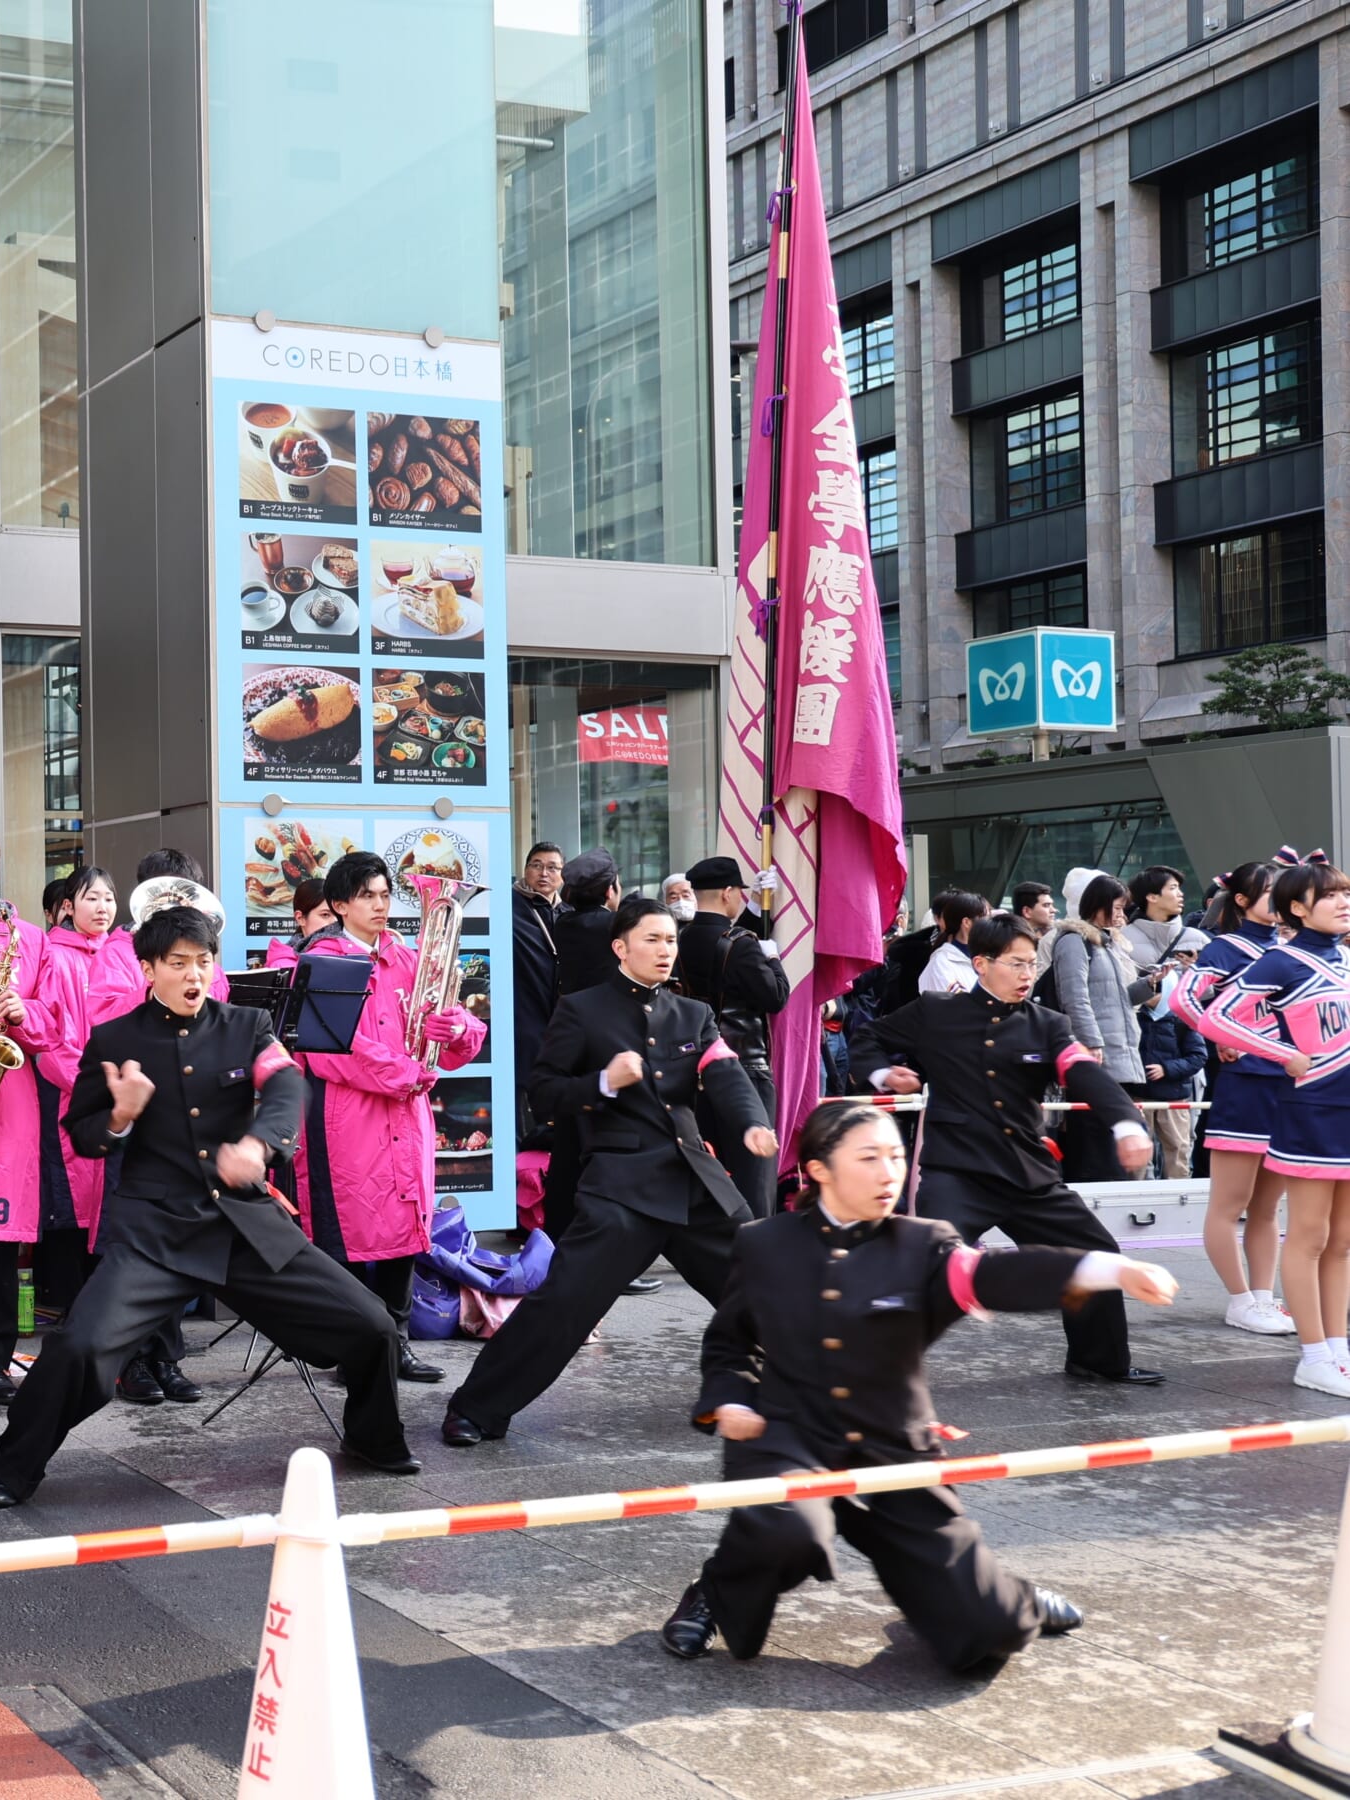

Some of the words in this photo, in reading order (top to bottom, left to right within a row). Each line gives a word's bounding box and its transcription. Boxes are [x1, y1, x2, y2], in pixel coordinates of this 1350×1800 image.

[262, 344, 452, 382] COREDO日本橋
[244, 505, 253, 513] B1
[260, 504, 324, 513] スープストックトーキョー
[372, 513, 382, 522] B1
[245, 635, 255, 645] B1
[375, 641, 385, 650] 3F
[247, 767, 258, 776] 4F
[377, 770, 387, 779] 4F
[250, 922, 260, 931] 4F
[247, 1601, 293, 1782] 立入禁止
